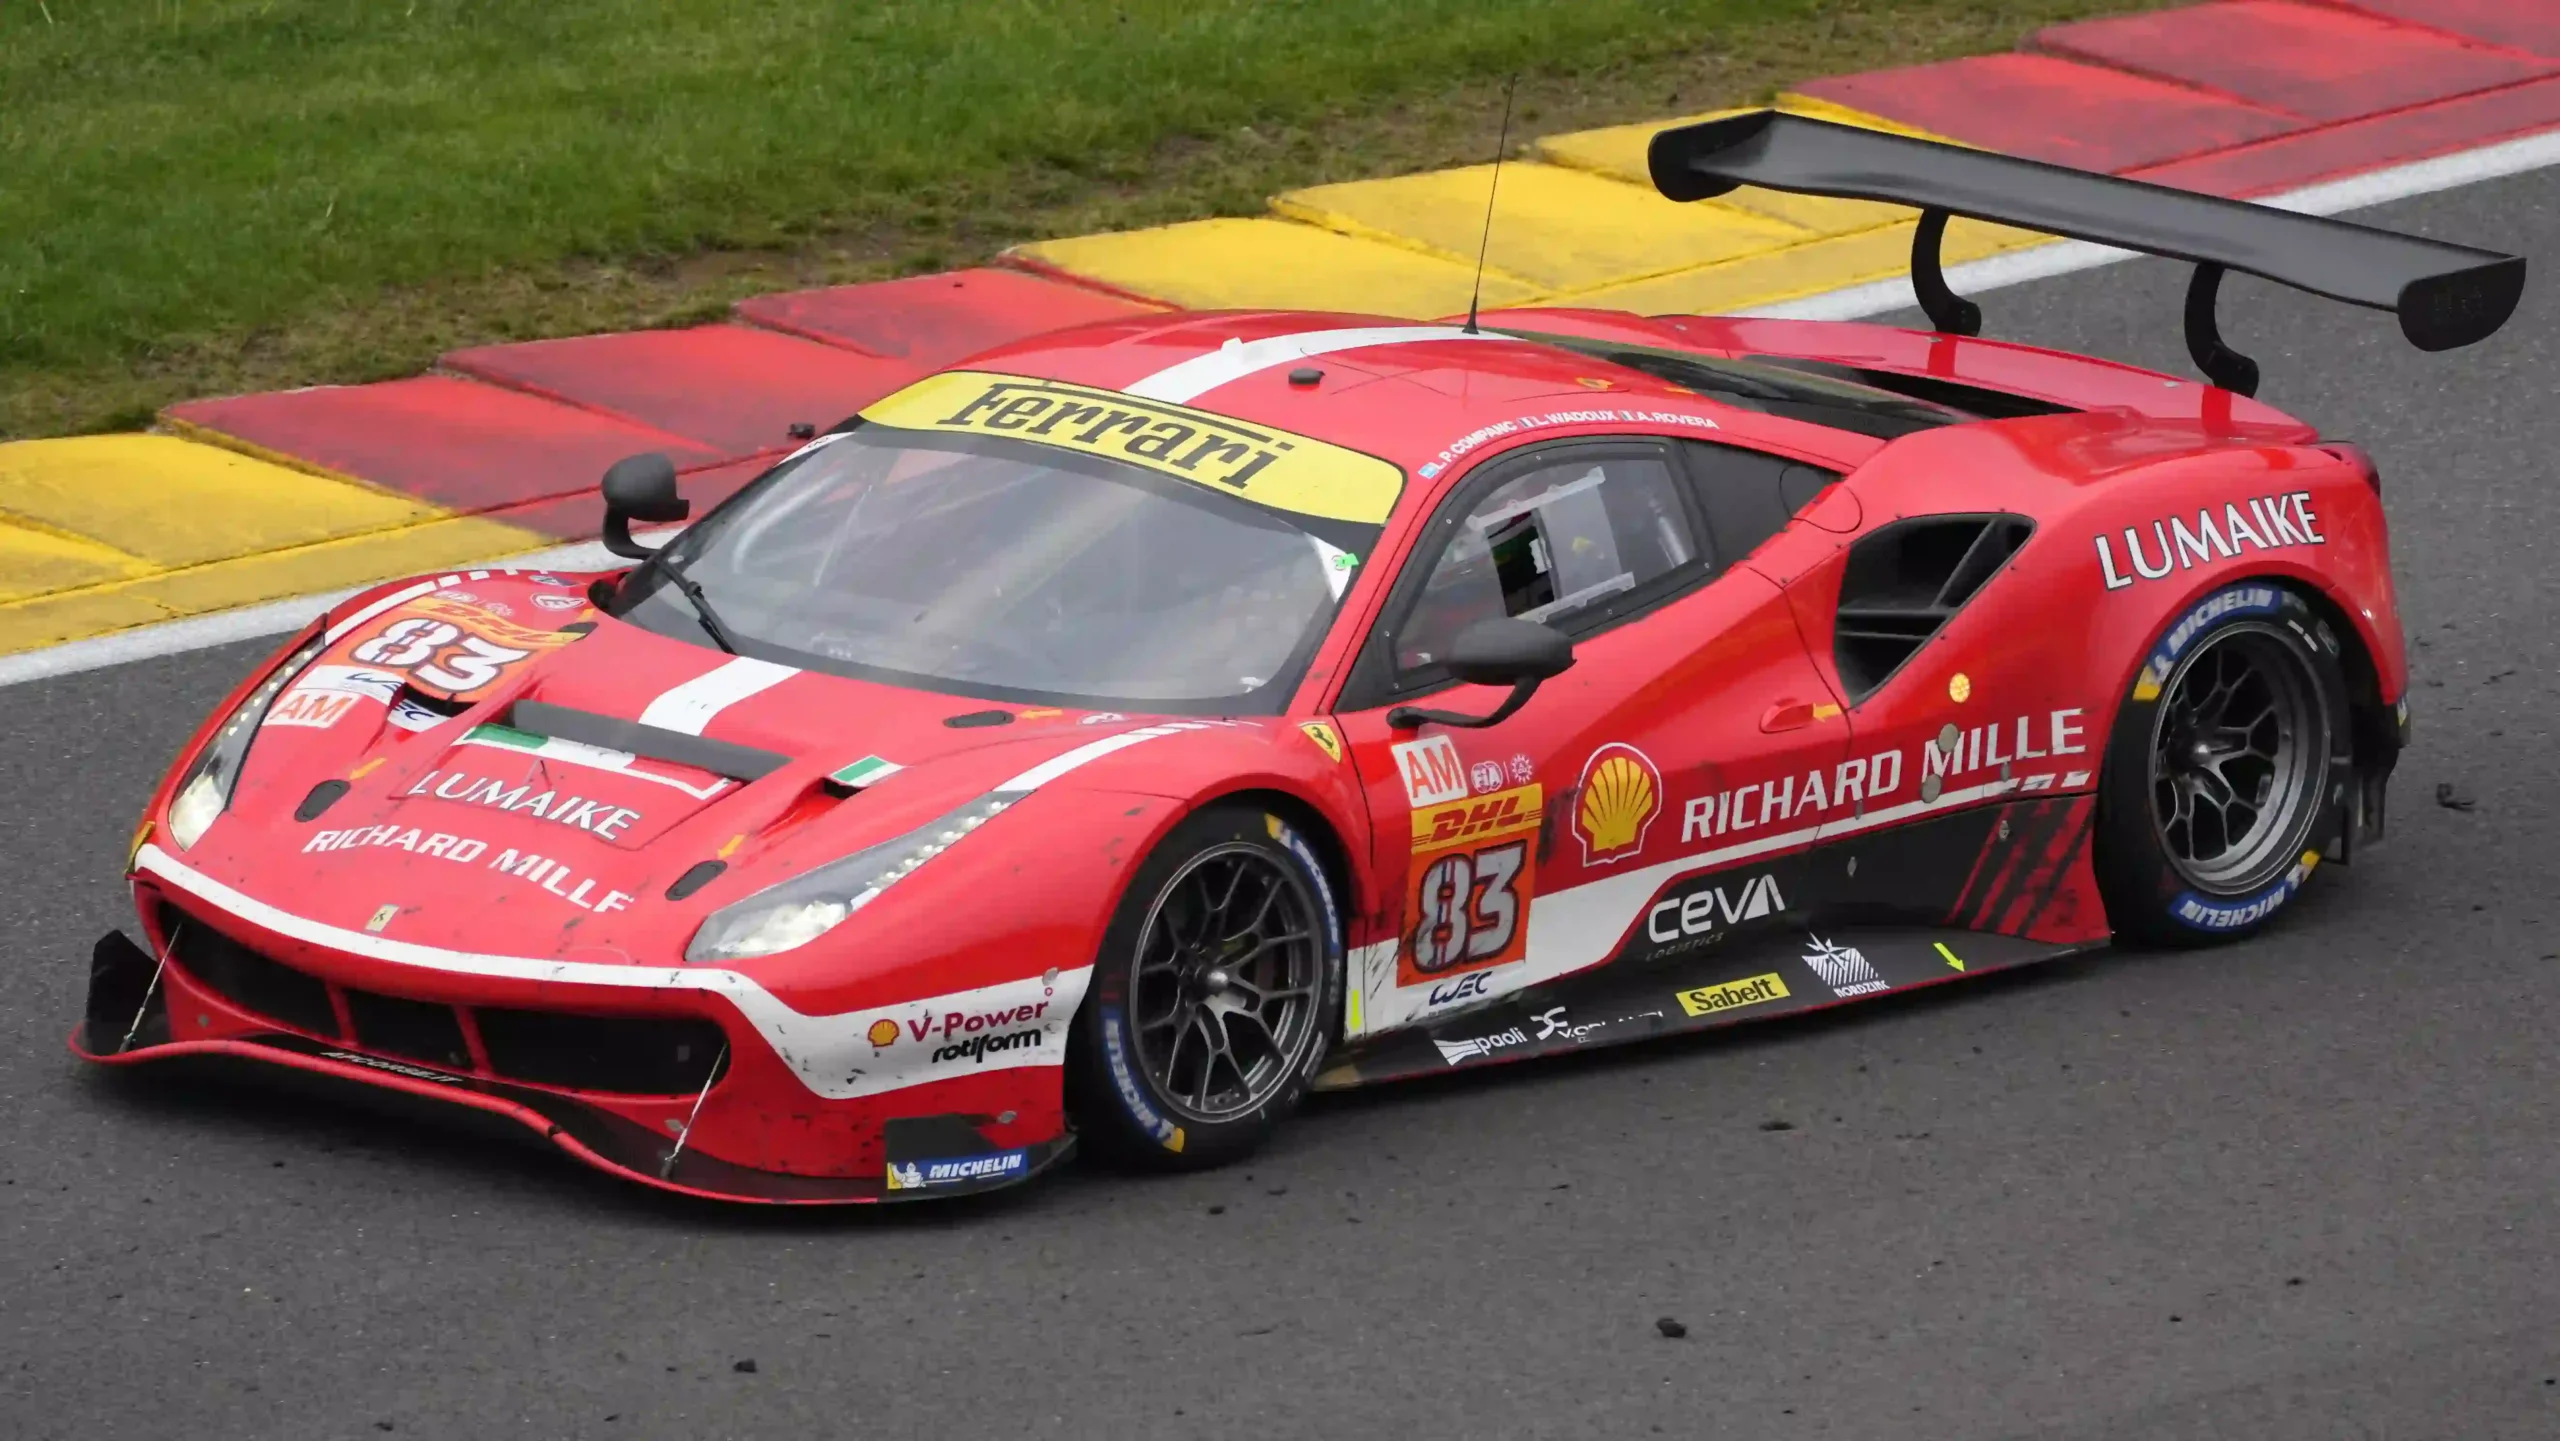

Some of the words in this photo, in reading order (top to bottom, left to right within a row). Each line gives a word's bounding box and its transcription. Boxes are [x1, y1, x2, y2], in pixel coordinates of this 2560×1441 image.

[936, 383, 1294, 489] Ferrari
[2095, 492, 2325, 594] LUMAIKE
[2167, 588, 2273, 652] MICHELIN
[350, 617, 530, 692] 83
[270, 693, 352, 721] AM
[1406, 743, 1464, 799] AM
[1681, 750, 1902, 843] RICHARD
[1921, 708, 2086, 781] MILLE
[407, 769, 640, 842] LUMAIKE
[1431, 796, 1526, 842] DHL
[302, 824, 488, 864] RICHARD
[1412, 840, 1528, 974] 83
[2178, 886, 2285, 928] MICHELIN
[1429, 971, 1493, 1006] WEC
[1692, 978, 1778, 1012] Sabelt
[907, 1001, 1049, 1043] V-Power
[1474, 1027, 1528, 1056] paoli
[931, 1028, 1041, 1064] rotiform
[928, 1155, 1022, 1179] MICHELIN
